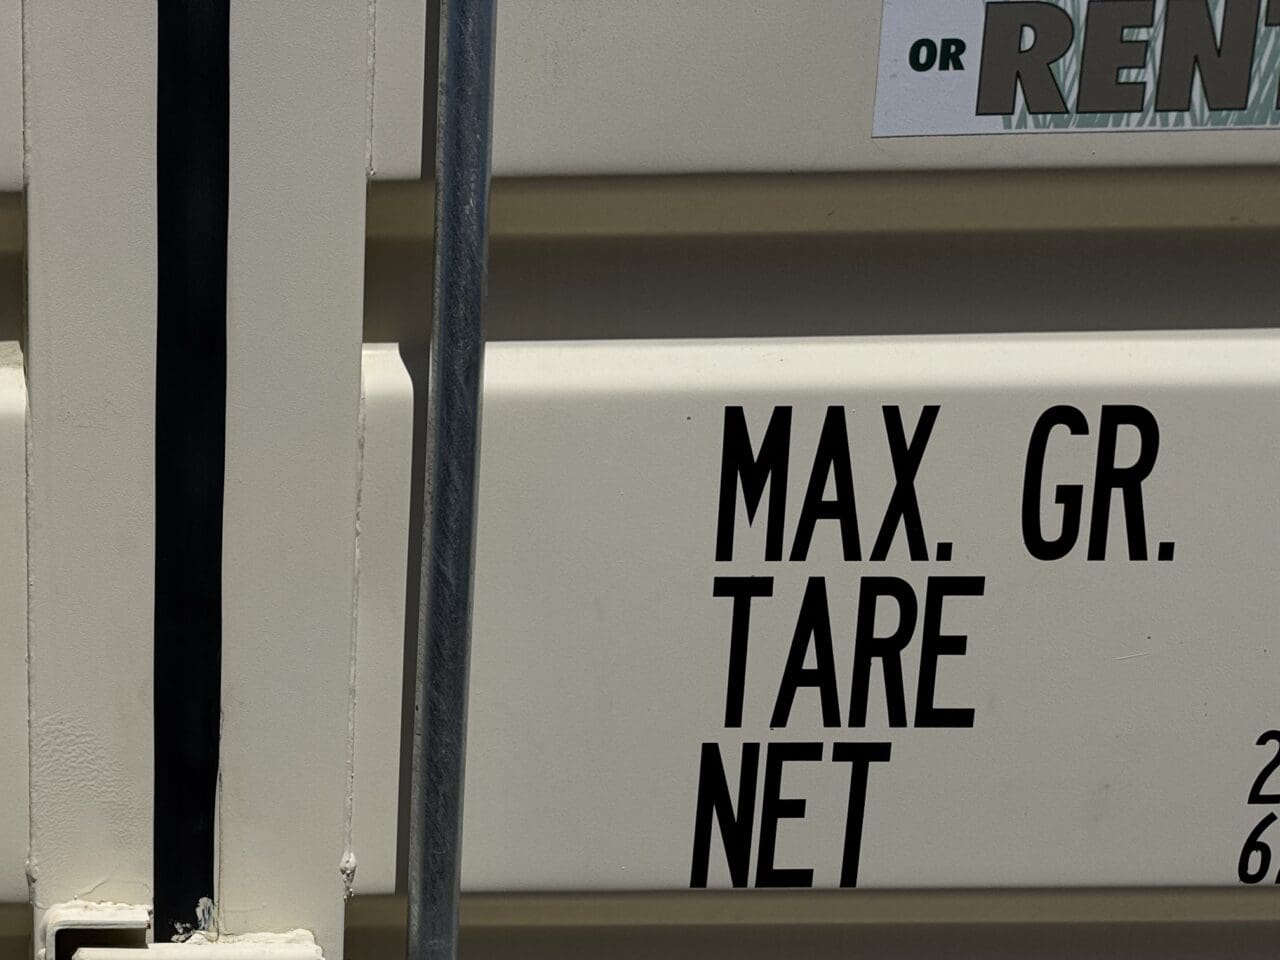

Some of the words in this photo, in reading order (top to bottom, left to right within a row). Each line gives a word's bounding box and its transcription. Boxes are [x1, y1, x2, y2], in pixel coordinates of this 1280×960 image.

[908, 37, 967, 72] OR
[715, 404, 953, 562] MAX.
[1021, 404, 1176, 562] GR.
[712, 575, 986, 729] TARE
[689, 741, 892, 888] NET
[1238, 811, 1280, 884] 6
